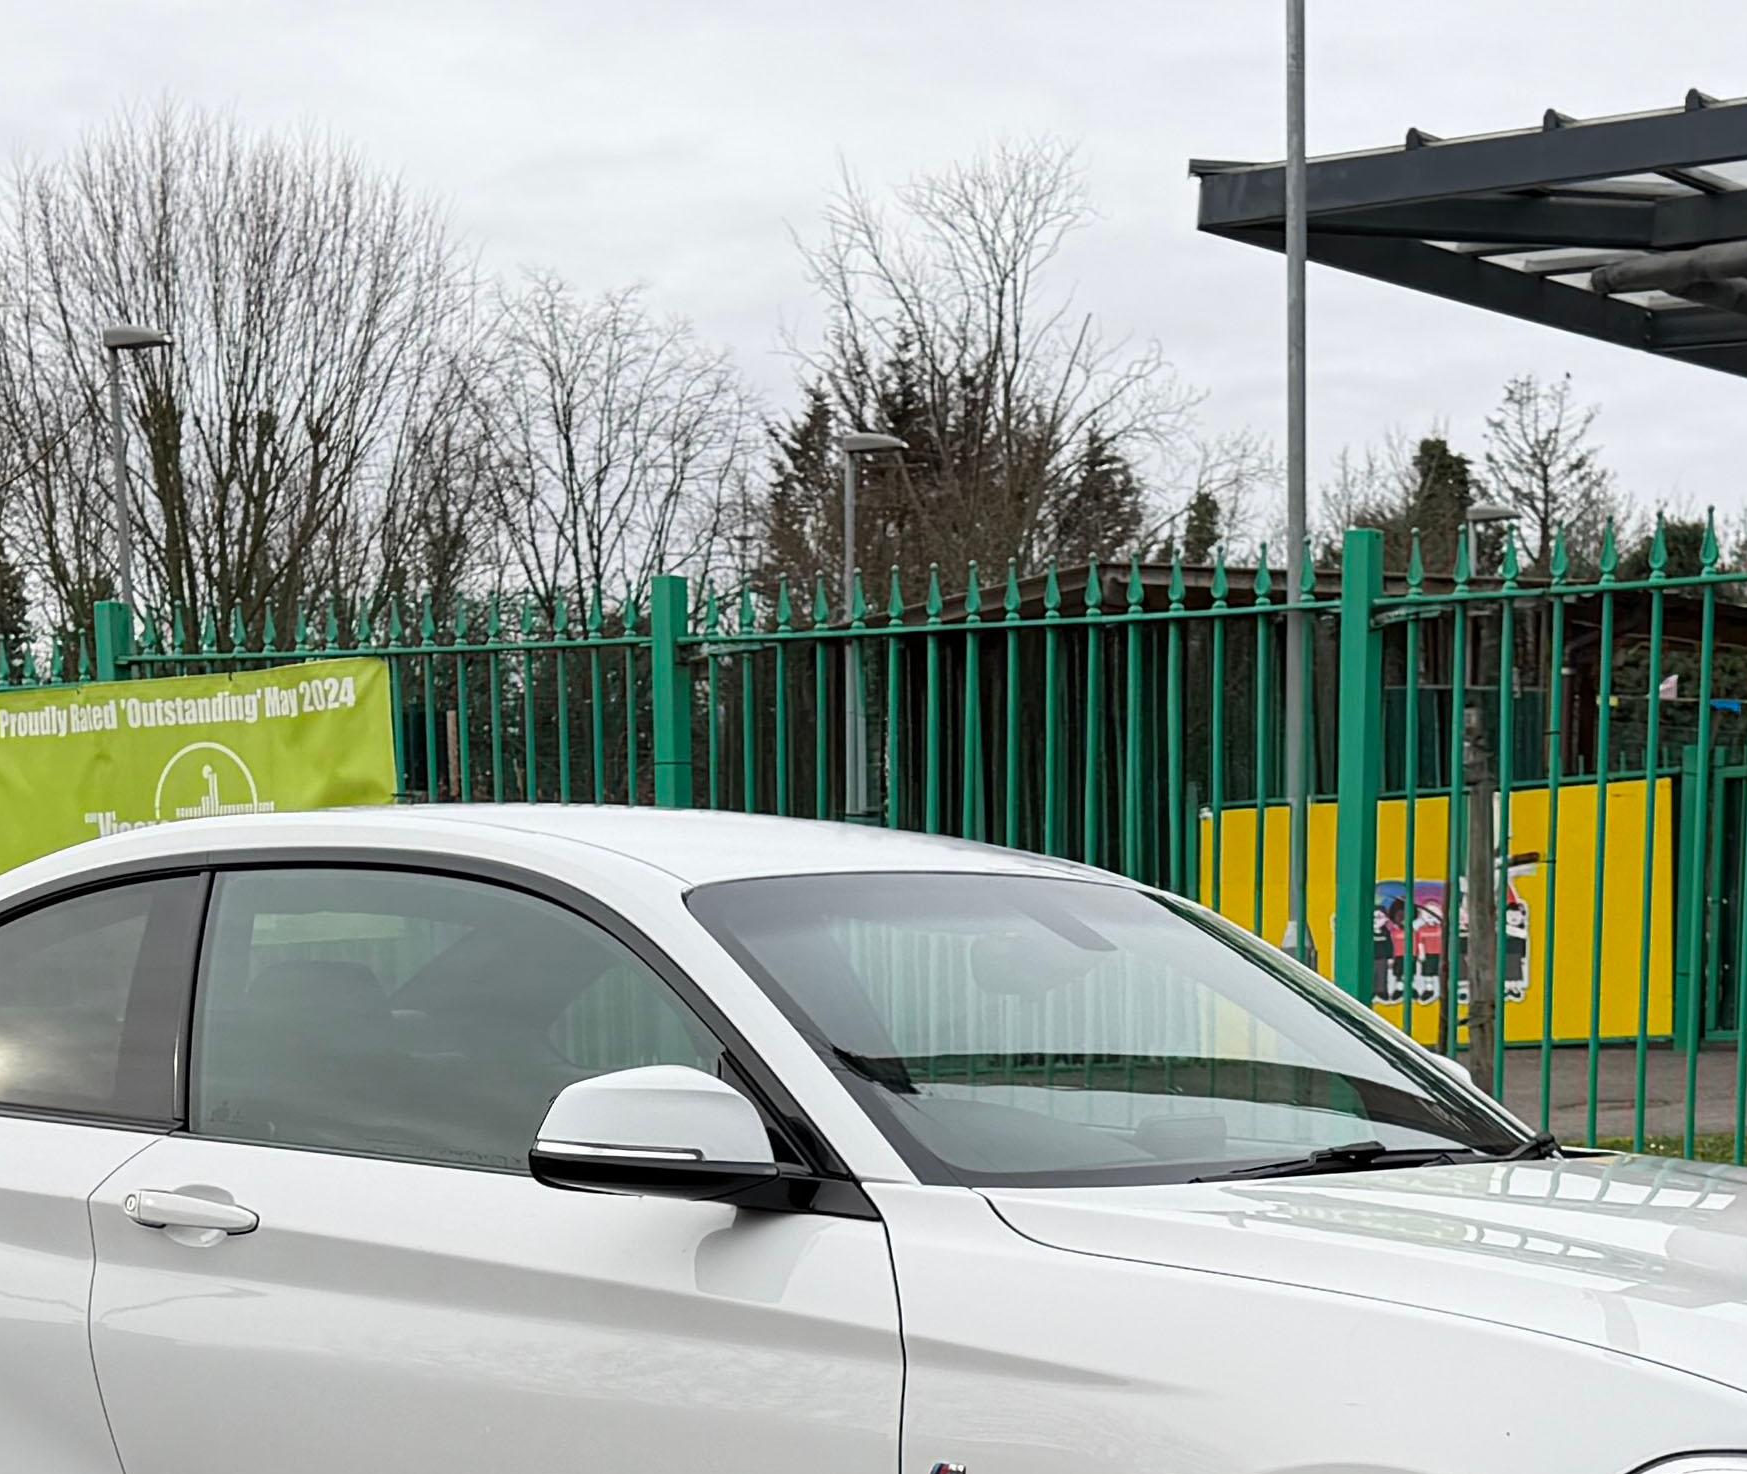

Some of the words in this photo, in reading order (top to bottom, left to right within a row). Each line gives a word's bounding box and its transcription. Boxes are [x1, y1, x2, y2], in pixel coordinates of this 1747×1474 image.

[70, 698, 118, 733] Rated
[120, 688, 261, 729] 'Outstanding'
[265, 685, 298, 718] May
[298, 676, 356, 713] 2024
